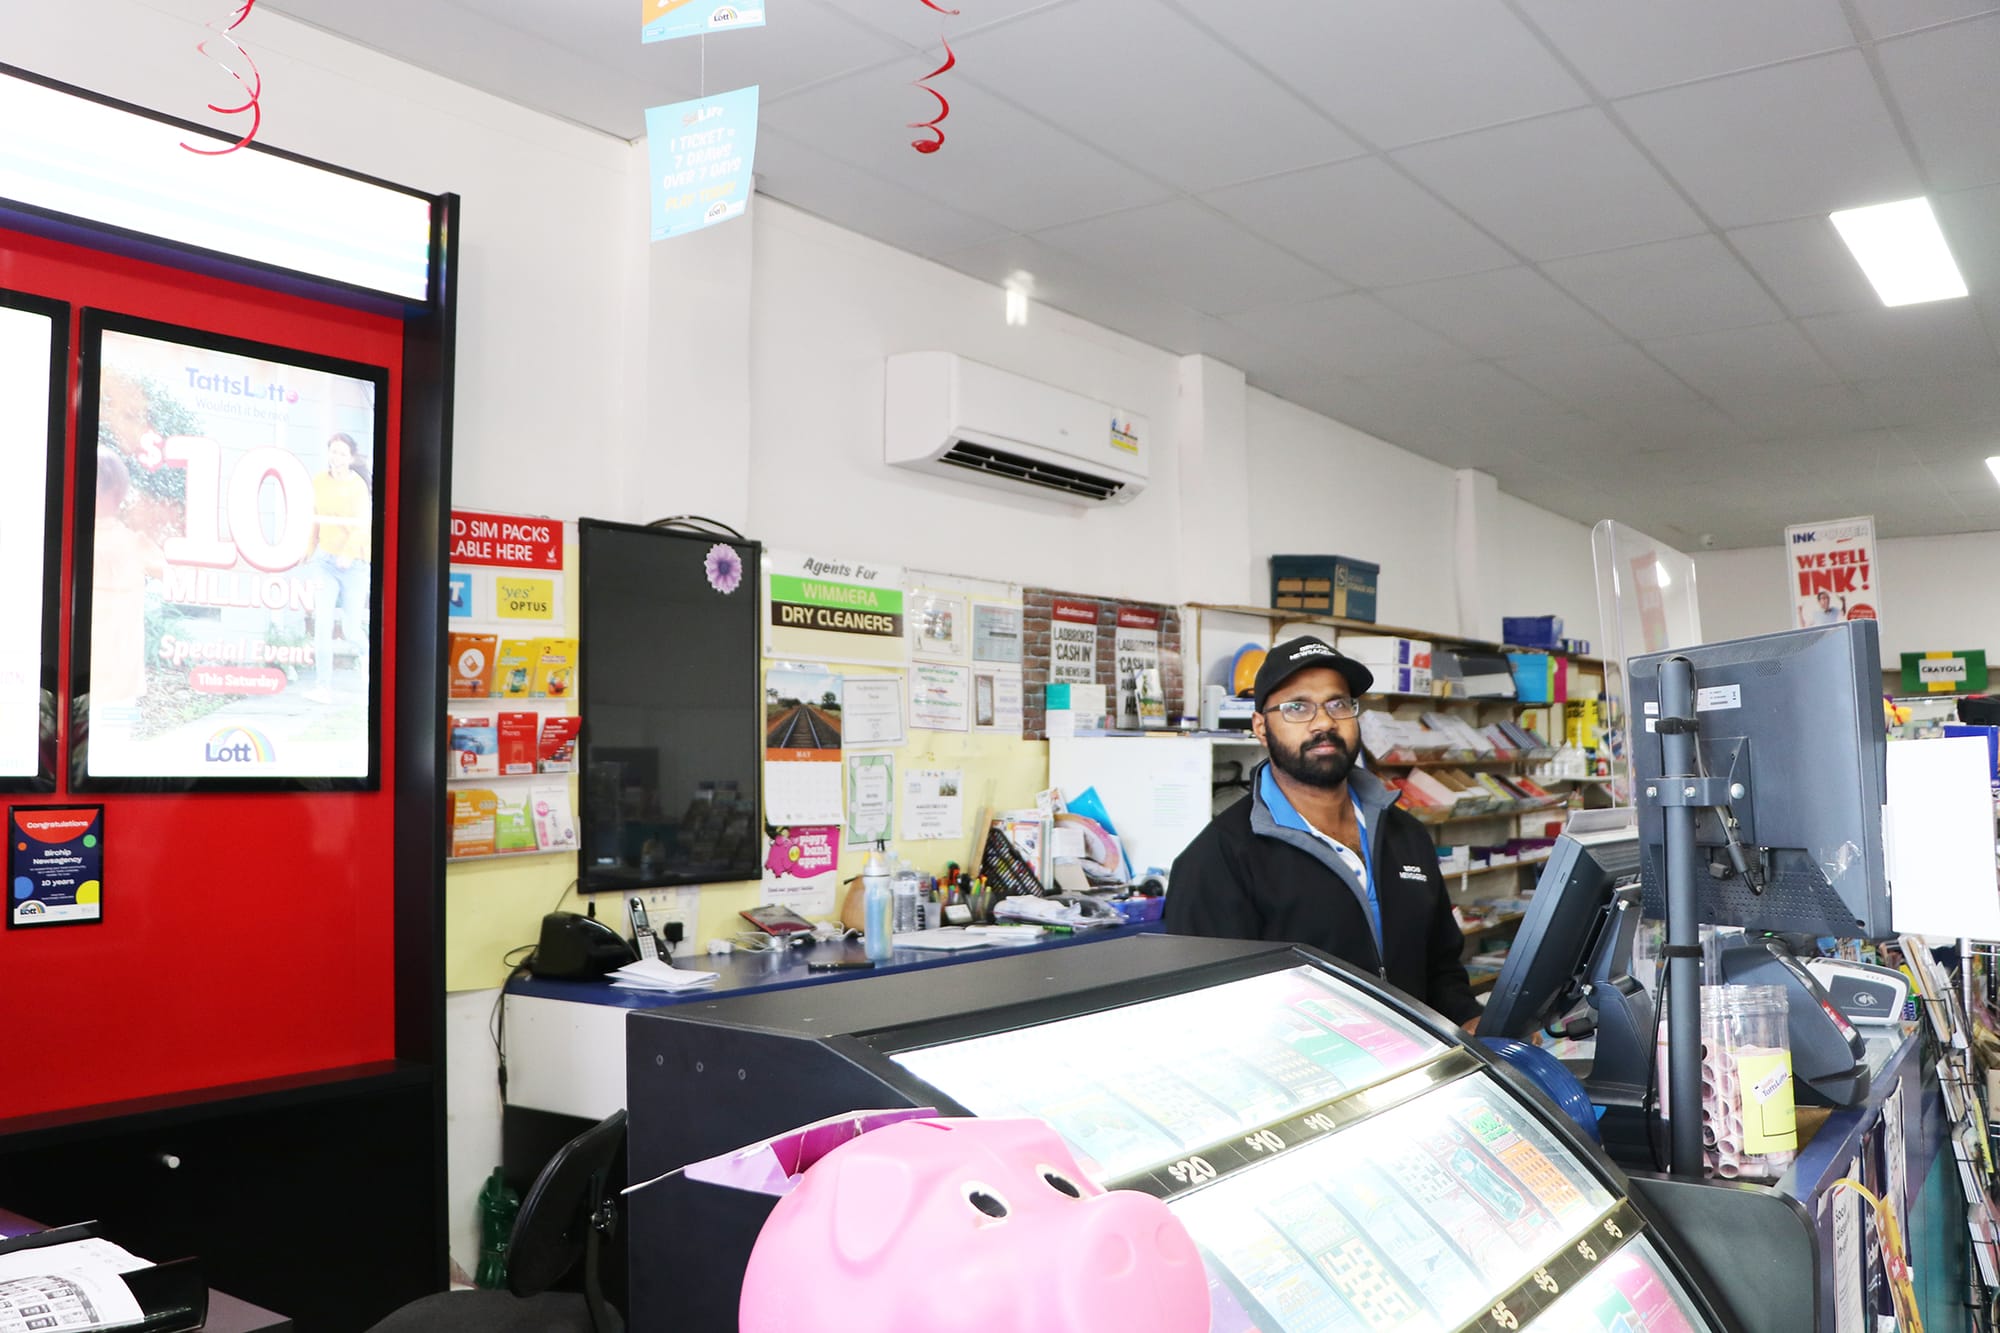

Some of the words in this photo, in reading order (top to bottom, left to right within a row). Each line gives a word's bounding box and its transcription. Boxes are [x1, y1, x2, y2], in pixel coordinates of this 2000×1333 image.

[680, 128, 726, 150] TICKET
[674, 155, 682, 169] 7
[663, 169, 696, 190] OVER
[699, 166, 707, 182] 7
[710, 157, 742, 178] DAYS
[471, 521, 499, 539] SIM
[502, 525, 550, 543] PACKS
[1793, 532, 1816, 543] INK
[496, 543, 533, 561] HERE
[1796, 553, 1826, 569] WE
[1829, 547, 1869, 566] SELL
[803, 557, 851, 576] Agents
[855, 566, 878, 580] For
[1798, 564, 1870, 597] INK!
[802, 582, 878, 607] WIMMERA
[510, 601, 548, 612] OPTUS
[782, 605, 815, 624] DRY
[817, 610, 894, 632] CLEANERS
[1053, 627, 1094, 643] LADBROKES
[159, 634, 248, 666] Special
[253, 639, 315, 665] Event
[1922, 665, 1964, 673] CRAYOLA
[198, 672, 223, 686] This
[225, 674, 278, 690] Saturday
[205, 743, 251, 762] Lott
[27, 820, 88, 829] Congratulations
[44, 849, 72, 857] Birchip
[803, 844, 832, 856] bank
[33, 857, 82, 865] Newsagency
[798, 855, 832, 869] appeal
[52, 878, 75, 887] years
[1304, 1112, 1336, 1131] $10
[1245, 1129, 1286, 1153] $10
[1168, 1156, 1217, 1185] $20
[1603, 1218, 1623, 1238] $5
[1577, 1239, 1597, 1261] $5
[1534, 1266, 1559, 1294] $5
[1491, 1300, 1519, 1330] $5
